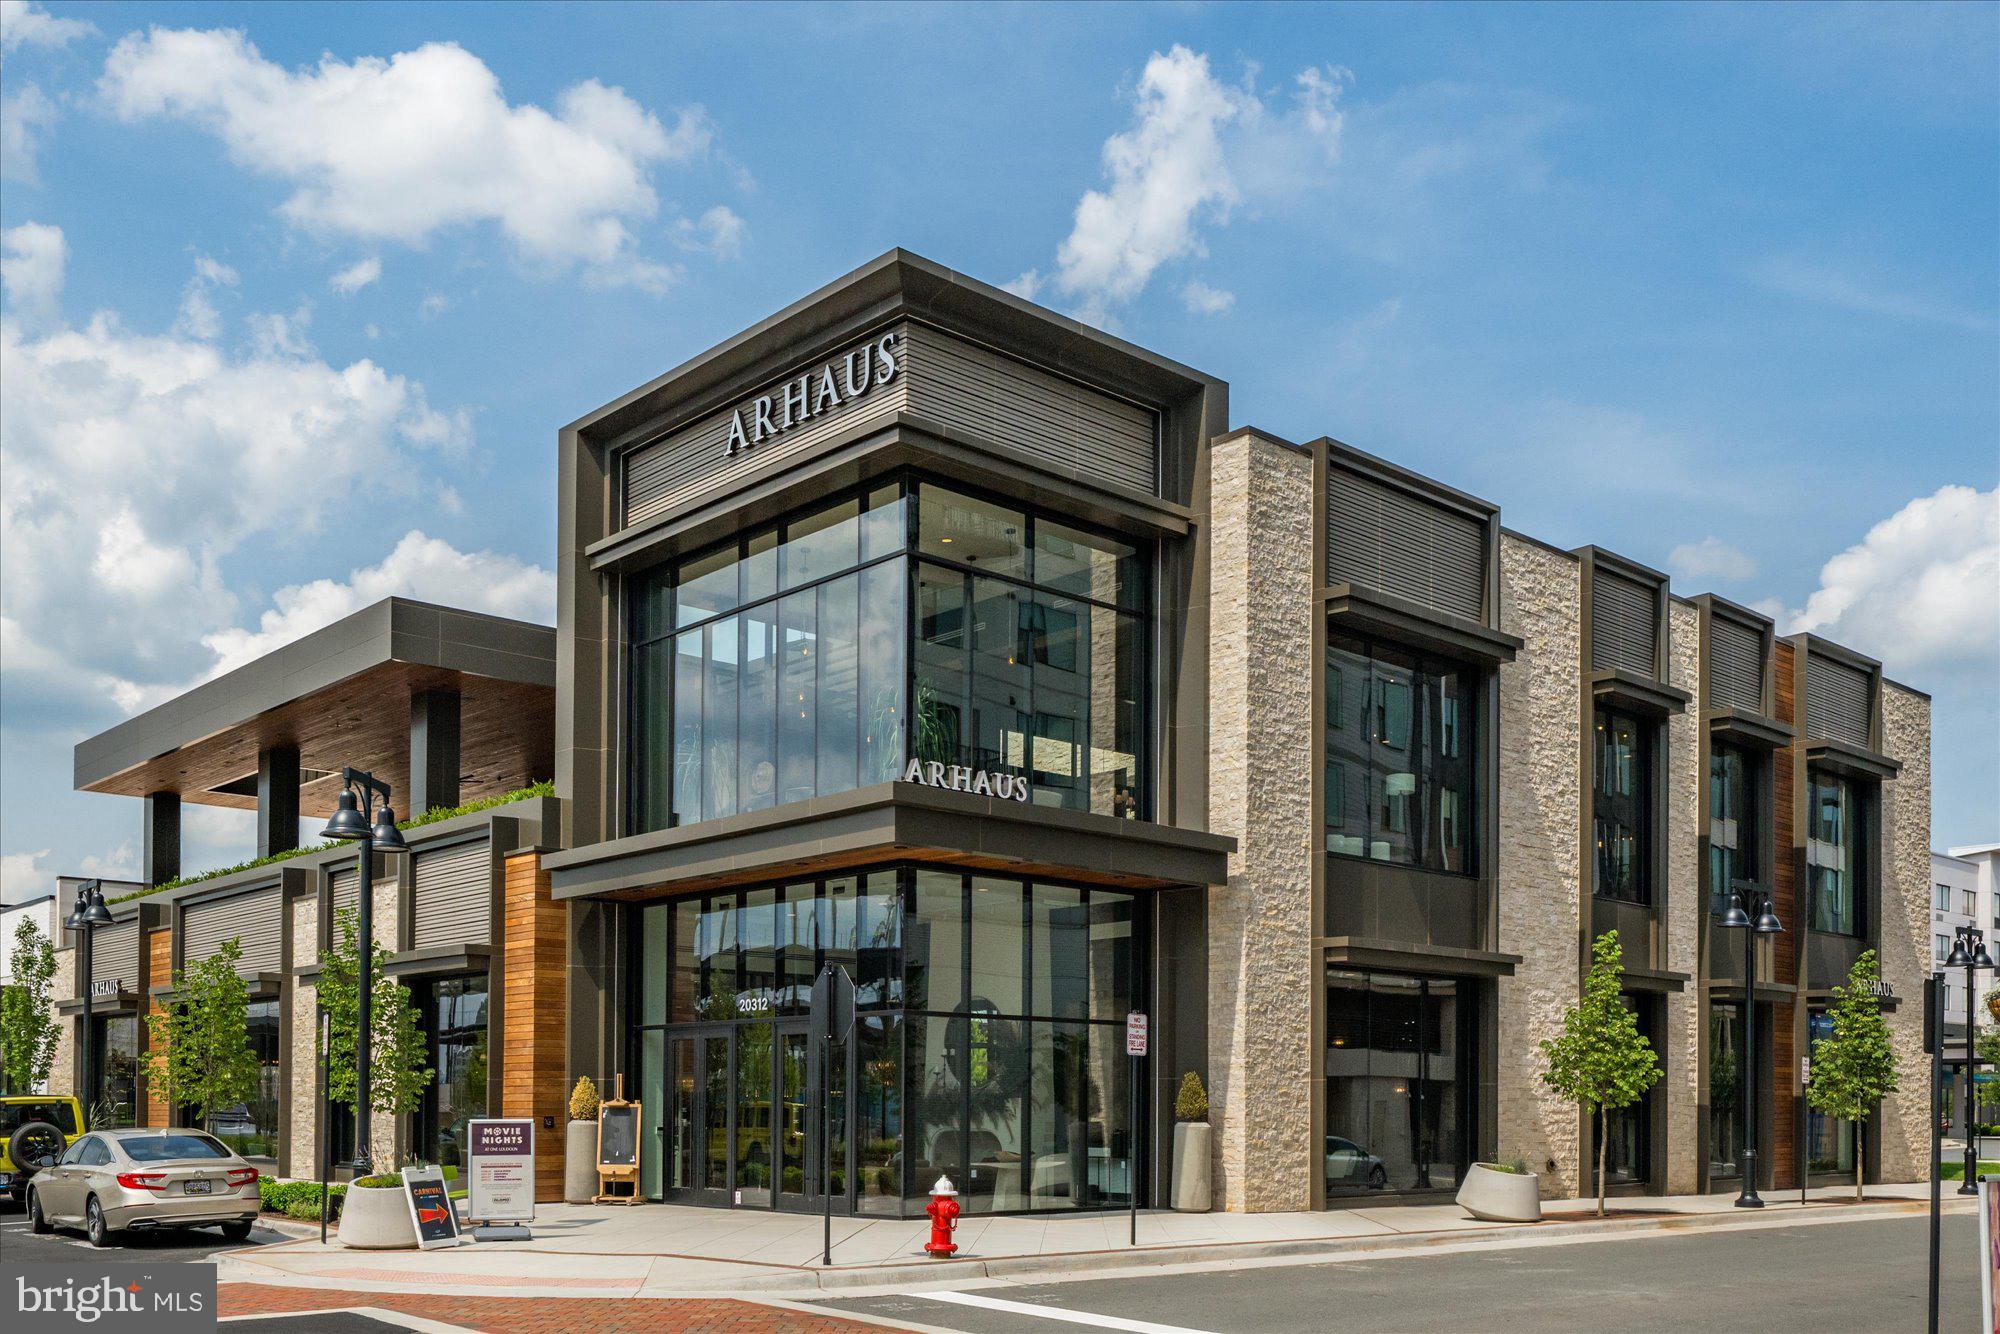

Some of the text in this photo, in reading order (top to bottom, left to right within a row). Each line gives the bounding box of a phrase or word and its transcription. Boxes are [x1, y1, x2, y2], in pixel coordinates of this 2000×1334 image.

[723, 332, 896, 457] ARHAUS
[904, 757, 1028, 802] ARHAUS
[740, 997, 768, 1011] 20312
[483, 1127, 521, 1136] MOVIE
[482, 1136, 523, 1144] NIGHTS
[413, 1187, 443, 1196] CARNIVAL
